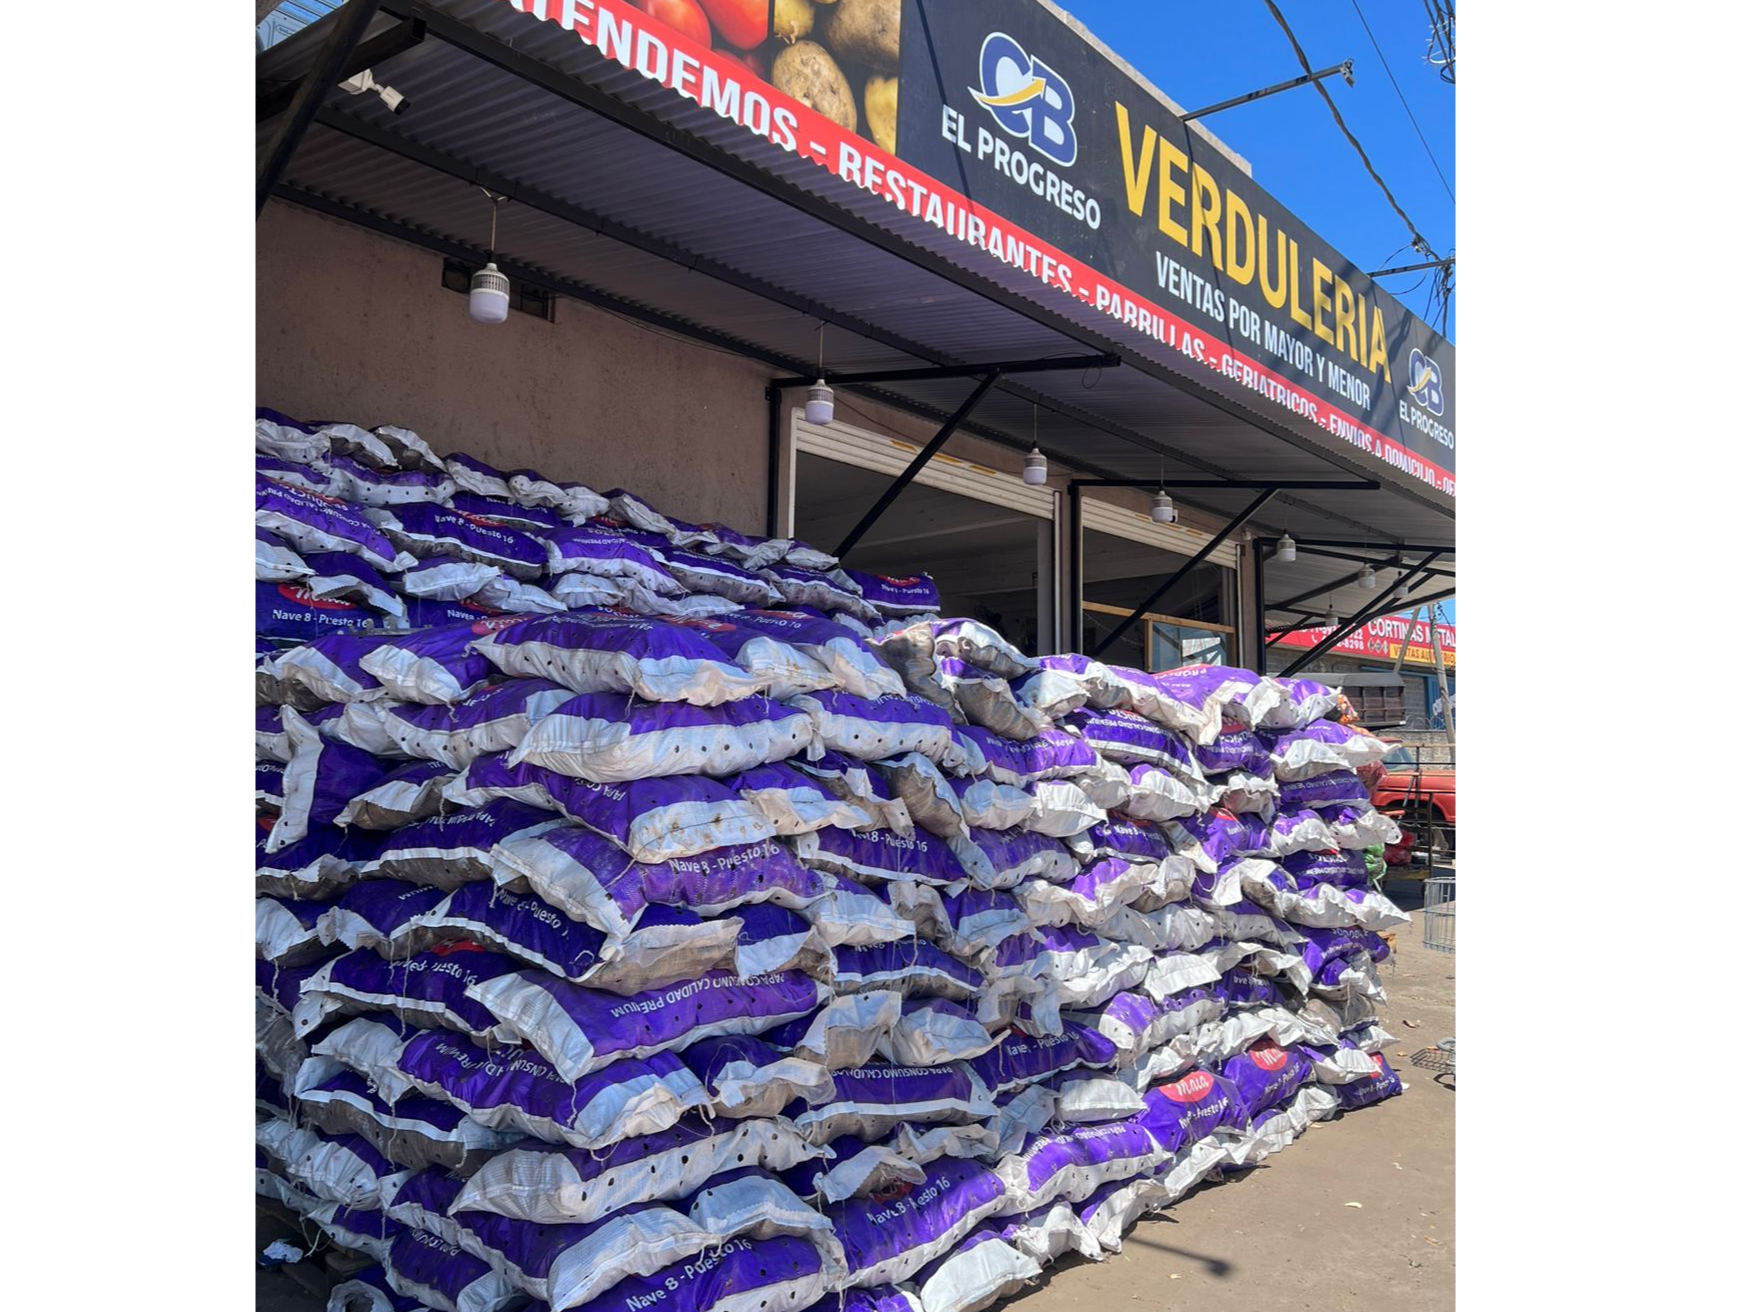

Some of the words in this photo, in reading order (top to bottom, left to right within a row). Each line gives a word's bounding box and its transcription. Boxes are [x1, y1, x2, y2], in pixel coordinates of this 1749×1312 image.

[510, 0, 797, 152] ENDEMOS
[942, 103, 971, 153] EL
[978, 126, 1101, 230] PROGRESO
[1115, 100, 1391, 383] VERDULERIA
[1155, 251, 1225, 323] VENTAS
[1229, 297, 1261, 345] POR
[1264, 319, 1313, 377] MAYOR
[1316, 353, 1325, 383] Y
[1328, 361, 1371, 411] MENOR
[1400, 399, 1410, 424] EL
[1411, 406, 1455, 450] PROGRESO
[272, 609, 302, 622] Nave
[304, 611, 311, 623] 8
[668, 858, 700, 874] Nave
[717, 846, 761, 870] Puesto
[762, 843, 781, 857] 16
[871, 831, 879, 843] 8
[886, 833, 915, 850] Puesto
[916, 840, 928, 853] 16
[665, 980, 712, 1008] CALIDAD
[938, 1176, 952, 1194] 16
[625, 1286, 667, 1312] Nave
[664, 1276, 679, 1291] 8
[685, 1241, 734, 1280] Puesto
[735, 1238, 752, 1253] 16
